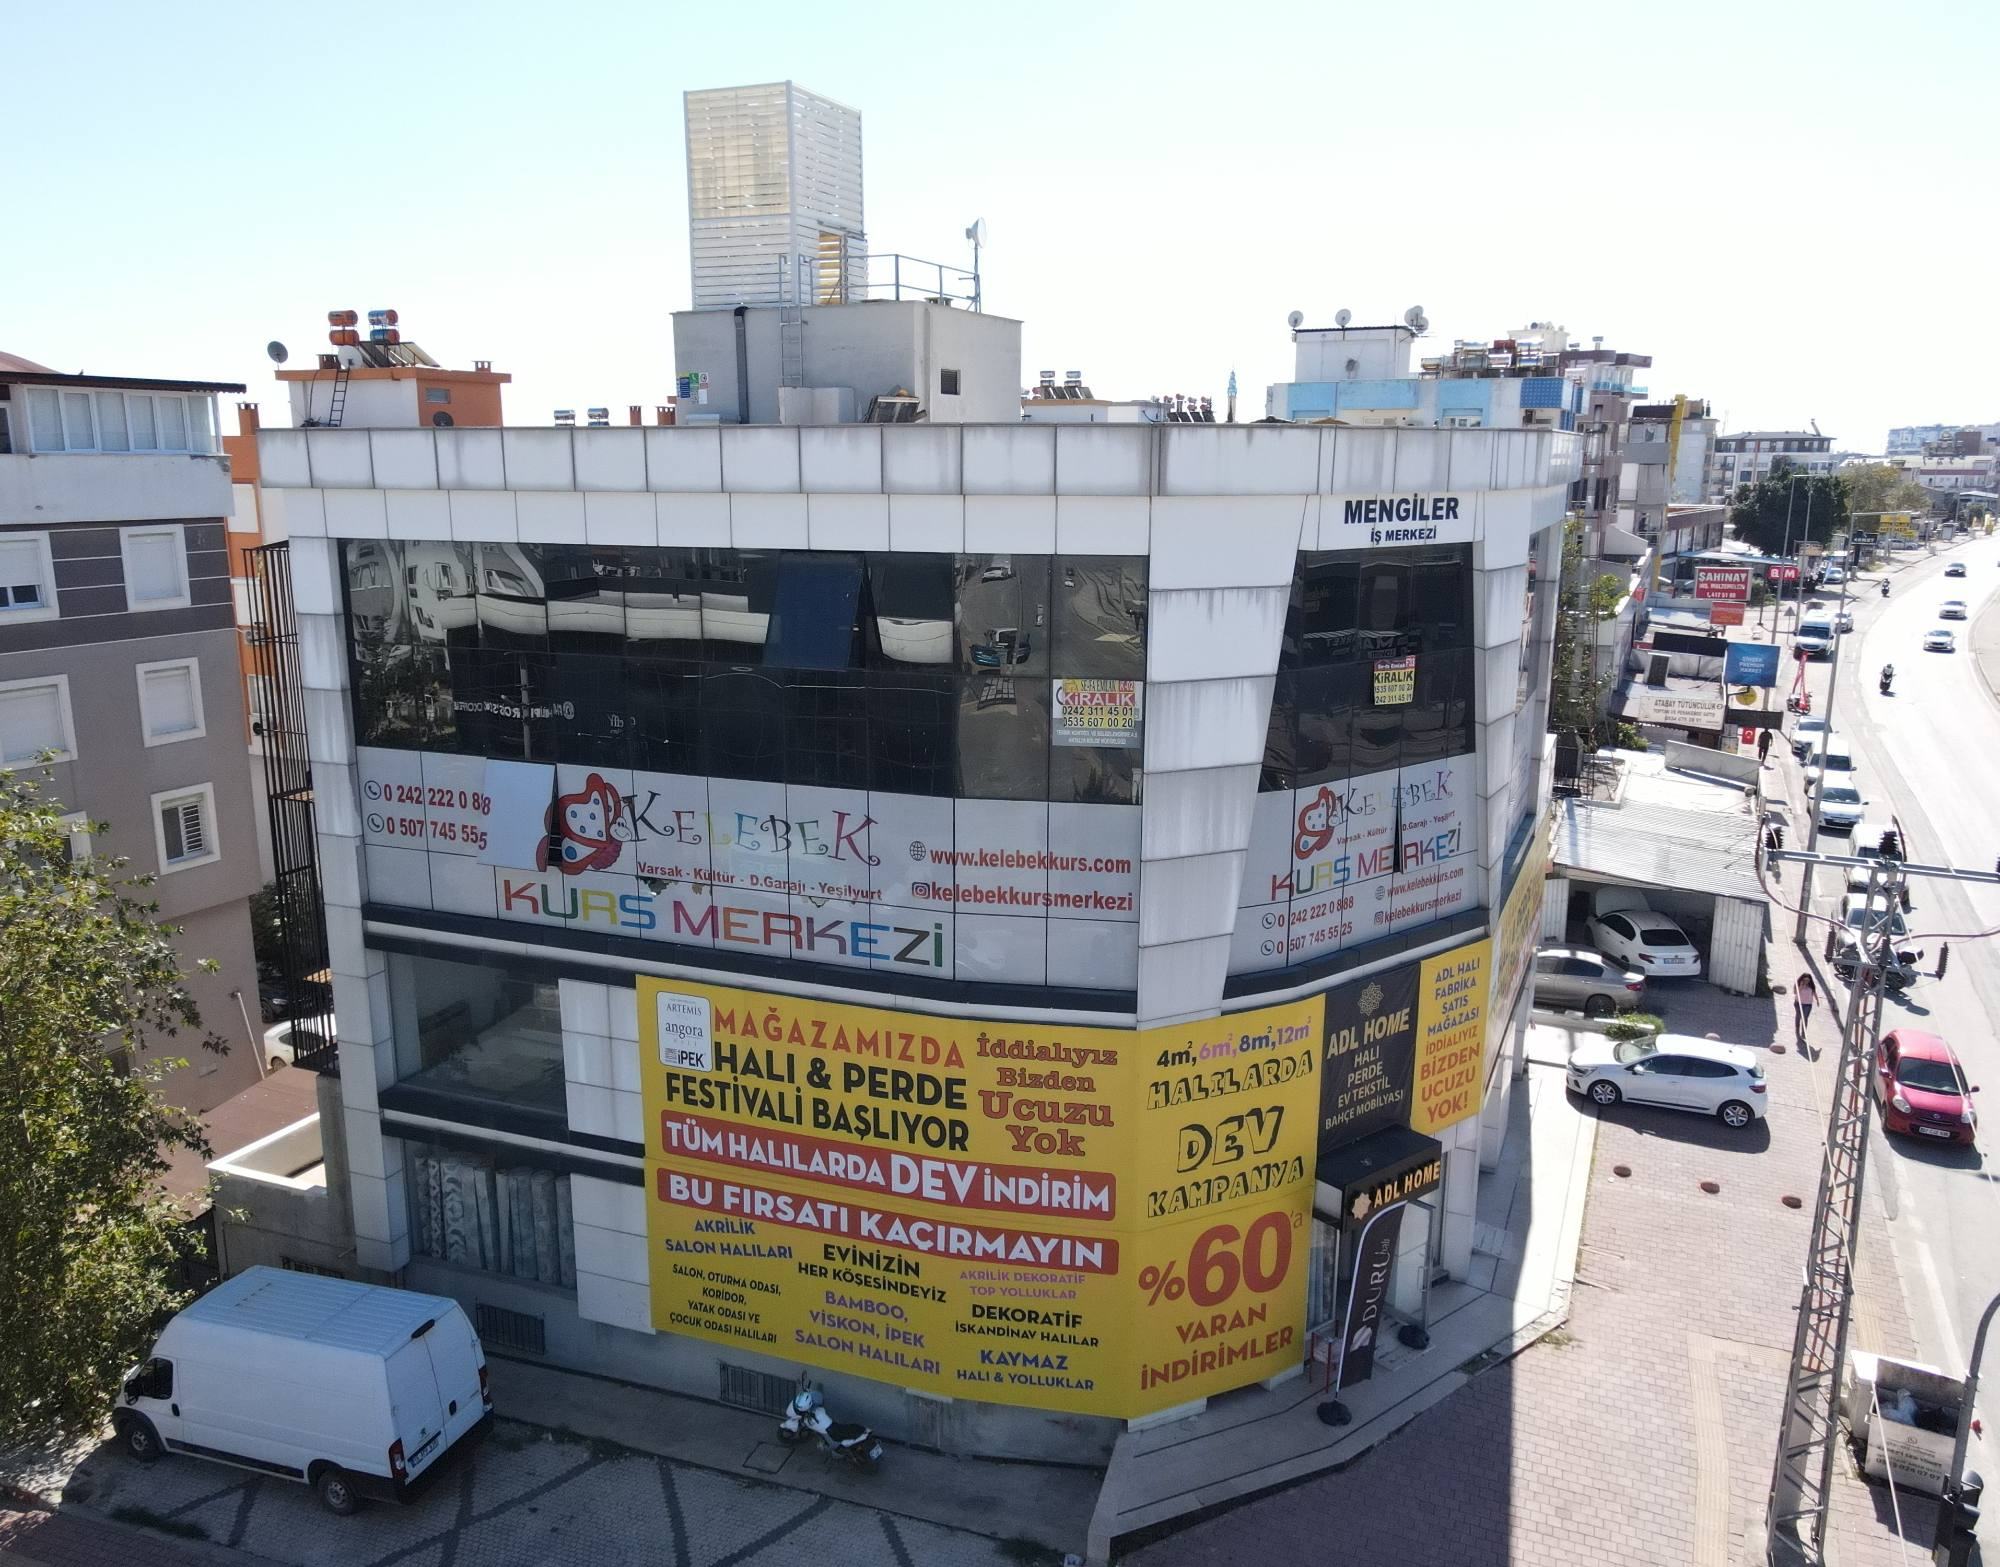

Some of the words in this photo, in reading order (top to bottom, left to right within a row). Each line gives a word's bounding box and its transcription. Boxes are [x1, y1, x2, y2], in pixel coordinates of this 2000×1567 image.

[1344, 493, 1459, 524] MENGİLER
[1370, 527, 1381, 545] İŞ
[1385, 525, 1437, 542] MERKEZİ
[1770, 569, 1795, 578] BM
[1062, 706, 1084, 716] 0242
[1088, 706, 1104, 716] 311
[1108, 706, 1119, 716] 45
[1122, 707, 1133, 716] 01
[1088, 718, 1104, 728] 607
[1108, 718, 1118, 728] 00
[1122, 718, 1133, 728] 20
[384, 784, 392, 802] 0
[396, 784, 423, 806] 242
[428, 787, 454, 808] 222
[458, 790, 468, 810] 0
[1337, 769, 1454, 827] KELEBEK
[386, 816, 395, 834] 0
[400, 818, 425, 838] 507
[430, 820, 456, 841] 745
[622, 790, 881, 866] KELEBEK
[930, 847, 1132, 874] www.kelebekkurs.com
[637, 862, 682, 878] Varsak
[693, 867, 735, 885] Kültür
[750, 874, 806, 893] D.Garajı
[818, 882, 882, 901] Yeşilyurt
[1271, 856, 1351, 902] KURS
[1387, 866, 1464, 898] www.kelebekkurs.com
[503, 879, 656, 930] KURS
[931, 882, 1133, 912] kelebekkursmerkezi
[1277, 914, 1285, 928] 0
[1290, 908, 1308, 926] 242
[1310, 903, 1327, 920] 222
[1329, 900, 1335, 913] 0
[1336, 896, 1354, 911] 888
[1384, 889, 1462, 924] kelebekkursmerkezi
[1276, 940, 1284, 954] 0
[1289, 935, 1306, 952] 507
[1309, 930, 1326, 946] 745
[1327, 926, 1339, 940] 55
[1341, 922, 1353, 937] 25
[1436, 968, 1454, 984] ADL
[1458, 957, 1480, 974] HALI
[1435, 976, 1476, 1000] FABRİKA
[666, 1022, 704, 1039] angora
[714, 1005, 966, 1068] MAĞAZAMIZDA
[1326, 1026, 1359, 1060] ADL
[1364, 1007, 1410, 1046] HOME
[1427, 1006, 1480, 1038] MAĞAZASI
[976, 1032, 1118, 1068] İddialıyız
[1354, 1045, 1380, 1068] HALI
[1426, 1024, 1478, 1056] İDDİALIYIZ
[714, 1041, 795, 1084] HALI
[806, 1057, 832, 1090] &
[844, 1062, 967, 1110] PERDE
[1348, 1061, 1383, 1088] PERDE
[1420, 1042, 1480, 1082] BİZDEN
[996, 1066, 1096, 1093] Bizden
[1147, 1050, 1314, 1111] HALILARDA
[1338, 1092, 1350, 1109] EV
[1353, 1074, 1391, 1102] TEKSTİL
[1421, 1066, 1476, 1102] UCUZU
[666, 1072, 802, 1126] FESTİVALİ
[812, 1097, 968, 1152] BAŞLIYOR
[978, 1089, 1114, 1128] Ucuzu
[1326, 1108, 1354, 1130] BAHÇE
[1356, 1089, 1404, 1117] MOBİLYASI
[1427, 1090, 1468, 1124] YOK!
[1005, 1124, 1086, 1157] Yok
[1176, 1106, 1284, 1174] DEV
[666, 1117, 724, 1156] TÜM
[728, 1132, 886, 1186] HALILARDA
[890, 1154, 978, 1203] DEV
[984, 1168, 1110, 1212] İNDİRİM
[1148, 1156, 1304, 1218] KAMPANYA
[1372, 1179, 1400, 1208] ADL
[1404, 1160, 1441, 1194] HOME
[670, 1174, 712, 1206] BU
[722, 1184, 848, 1232] FIRSATI
[860, 1210, 1104, 1269] KAÇIRMAYIN
[694, 1216, 756, 1234] AKRİLİK
[665, 1238, 716, 1254] SALON
[720, 1242, 793, 1259] HALILARI
[823, 1242, 920, 1279] EVİNİZİN
[672, 1263, 706, 1280] SALON,
[708, 1270, 747, 1288] OTURMA
[750, 1280, 782, 1296] ODASI,
[798, 1262, 828, 1279] HER
[832, 1263, 947, 1304] KÖŞESİNDEYİZ
[960, 1269, 1010, 1282] AKRİLİK
[1013, 1270, 1086, 1285] DEKORATİF
[969, 1285, 996, 1296] TOP
[1000, 1286, 1077, 1300] YOLLUKLAR
[1362, 1250, 1390, 1322] DURU
[688, 1300, 715, 1316] YATAK
[717, 1306, 746, 1322] ODASI
[748, 1312, 760, 1324] VE
[702, 1286, 747, 1306] KORİDOR,
[825, 1290, 908, 1324] BAMBOO,
[670, 1312, 702, 1328] ÇOCUK
[704, 1320, 732, 1334] ODASI
[734, 1326, 777, 1344] HALILARI
[809, 1308, 880, 1340] VİSKON,
[884, 1323, 925, 1349] İPEK
[972, 1303, 1083, 1328] DEKORATİF
[1176, 1302, 1267, 1344] VARAN
[955, 1320, 1037, 1340] İSKANDİNAV
[1040, 1332, 1099, 1348] HALILAR
[794, 1330, 853, 1354] SALON
[858, 1344, 940, 1376] HALILARI
[980, 1349, 1069, 1370] KAYMAZ
[1141, 1325, 1294, 1391] İNDİRİMLER
[956, 1369, 990, 1381] HALI
[994, 1372, 1004, 1382] &
[1008, 1372, 1094, 1391] YOLLUKLAR
